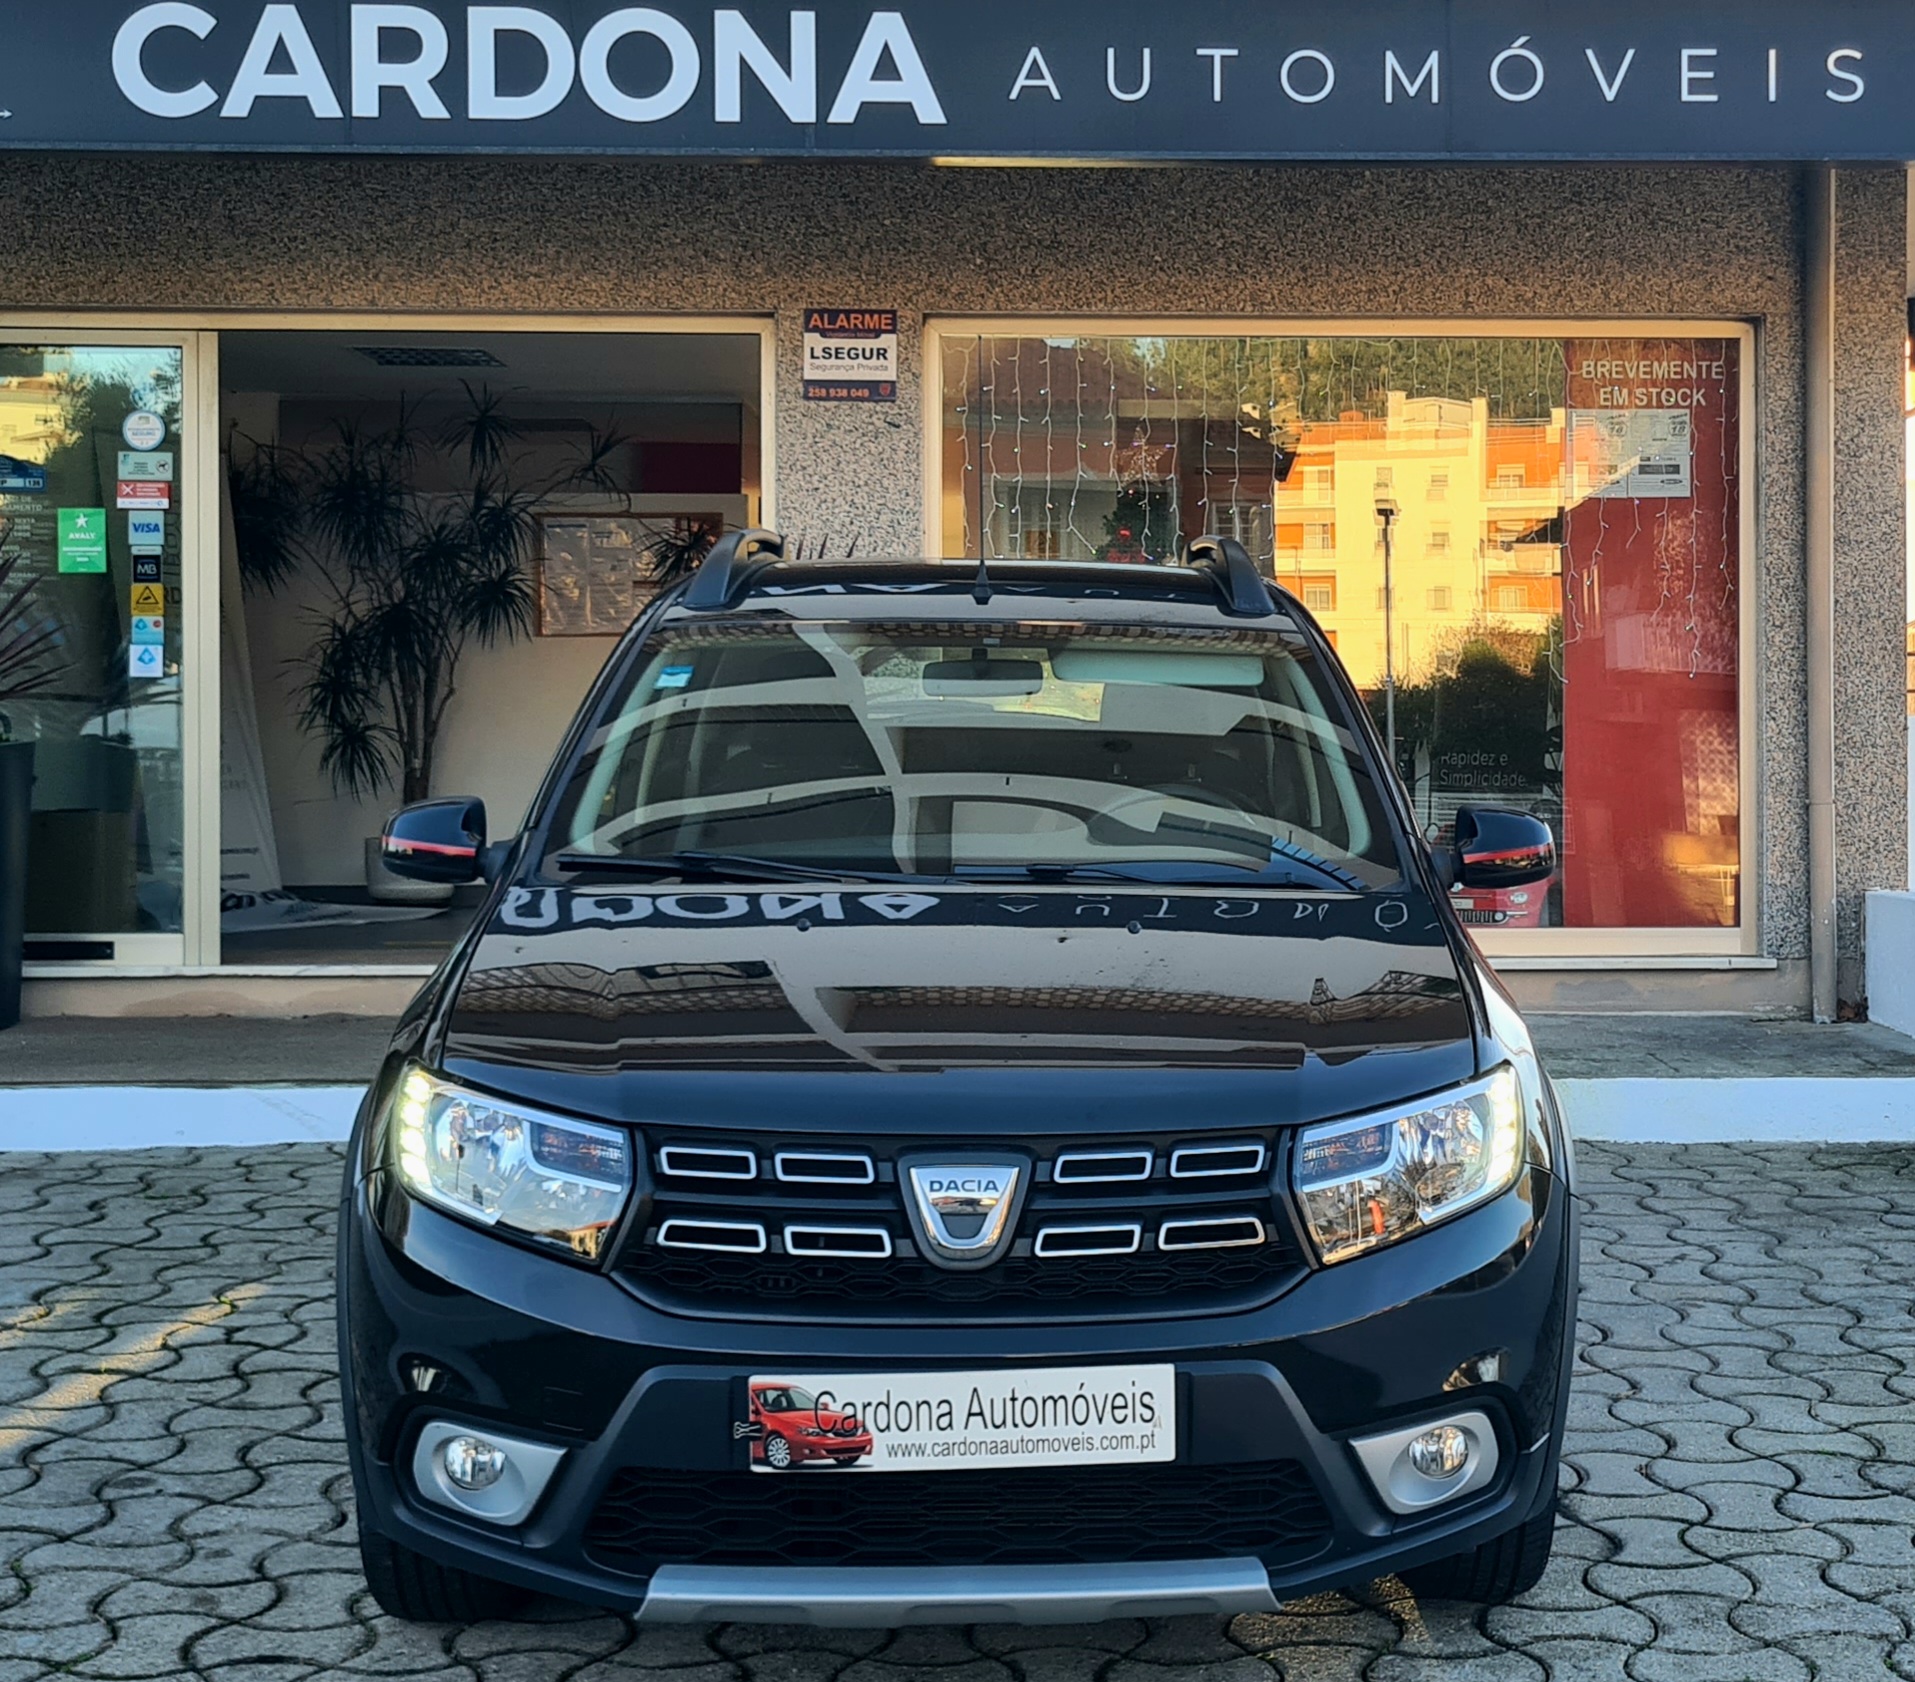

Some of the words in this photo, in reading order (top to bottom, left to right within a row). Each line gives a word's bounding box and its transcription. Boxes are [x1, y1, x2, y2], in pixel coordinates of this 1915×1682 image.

[111, 1, 948, 125] CARDONA
[1008, 35, 1867, 104] AUTOMÓVEIS
[808, 312, 894, 331] ALARME
[809, 346, 889, 361] LSEGUR
[809, 362, 855, 373] Segurança
[856, 363, 889, 372] Privada
[1582, 360, 1724, 379] BREVEMENTE
[1599, 388, 1629, 406] EM
[1635, 387, 1706, 406] STOCK
[132, 523, 160, 533] VISA
[136, 564, 158, 576] MB
[1499, 753, 1509, 766] e
[929, 1179, 1000, 1193] DACIA
[813, 1388, 954, 1435] Cardona
[964, 1380, 1157, 1432] Automóveis
[885, 1429, 1157, 1459] www.cardonaautomoveis.com.pt
